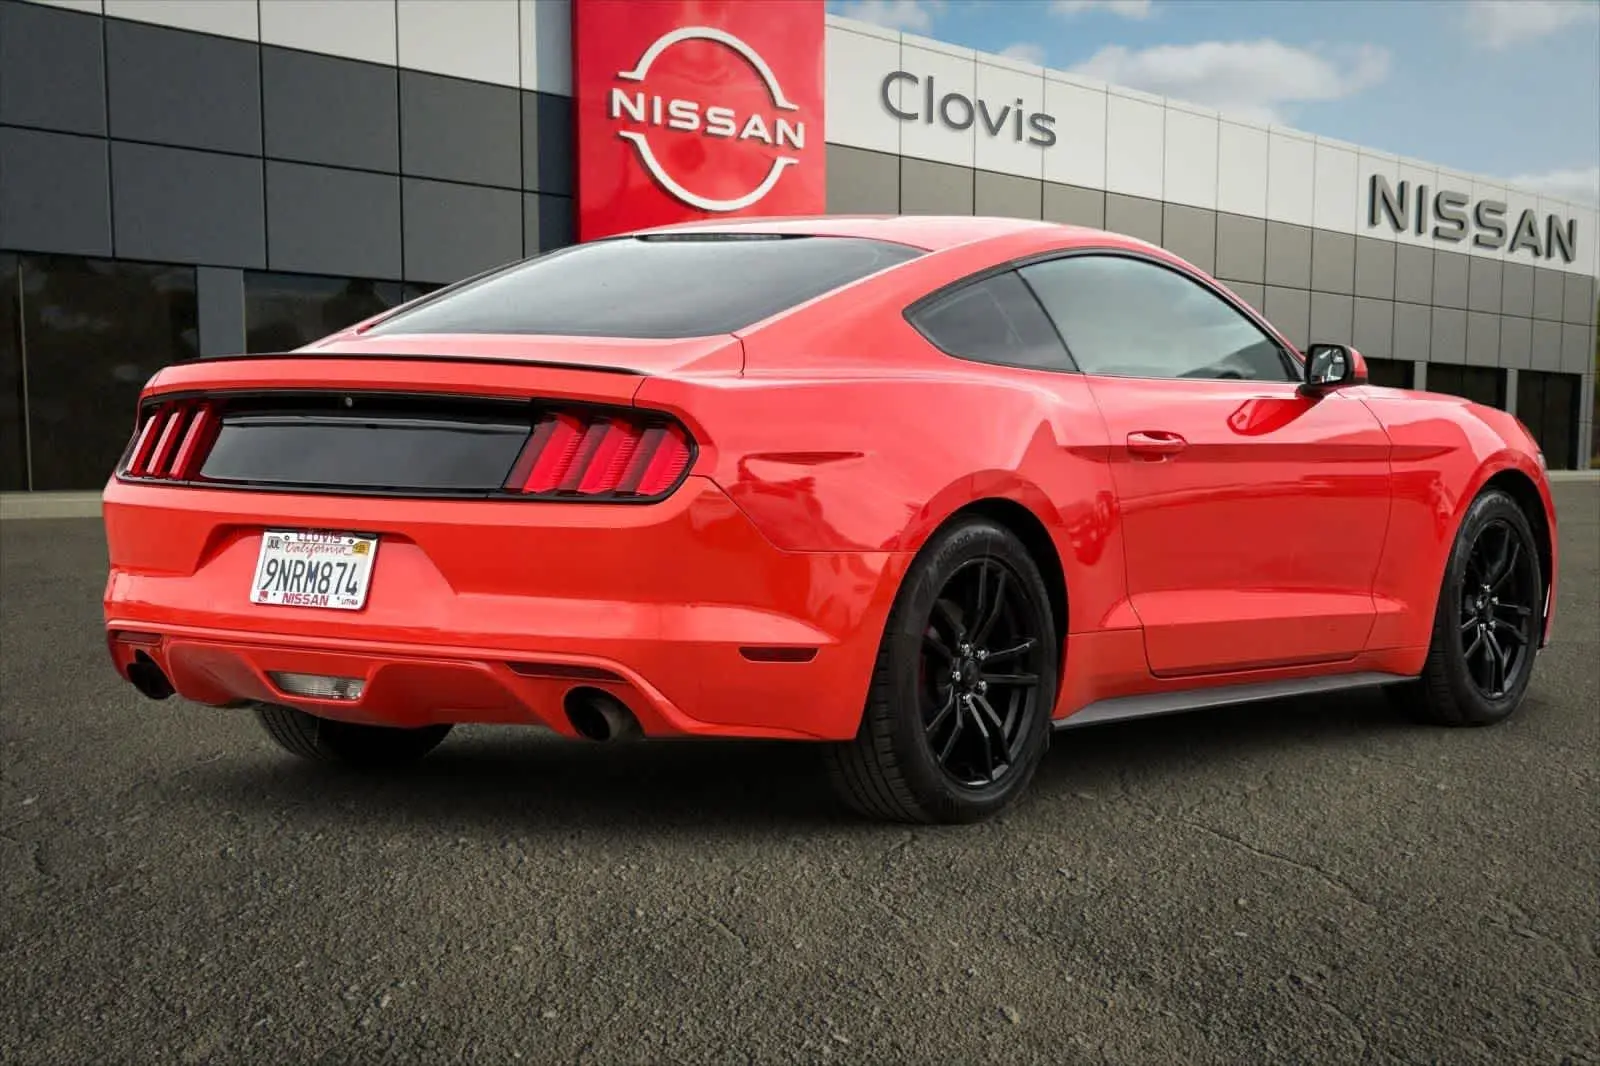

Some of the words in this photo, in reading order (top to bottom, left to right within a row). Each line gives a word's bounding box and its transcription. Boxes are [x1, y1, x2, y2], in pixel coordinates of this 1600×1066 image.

[610, 87, 805, 149] NISSAN
[881, 70, 1057, 147] Clovis
[1369, 173, 1577, 263] NISSAN
[285, 542, 348, 559] California
[261, 558, 357, 596] 9NRM874
[282, 593, 329, 606] NISSAN
